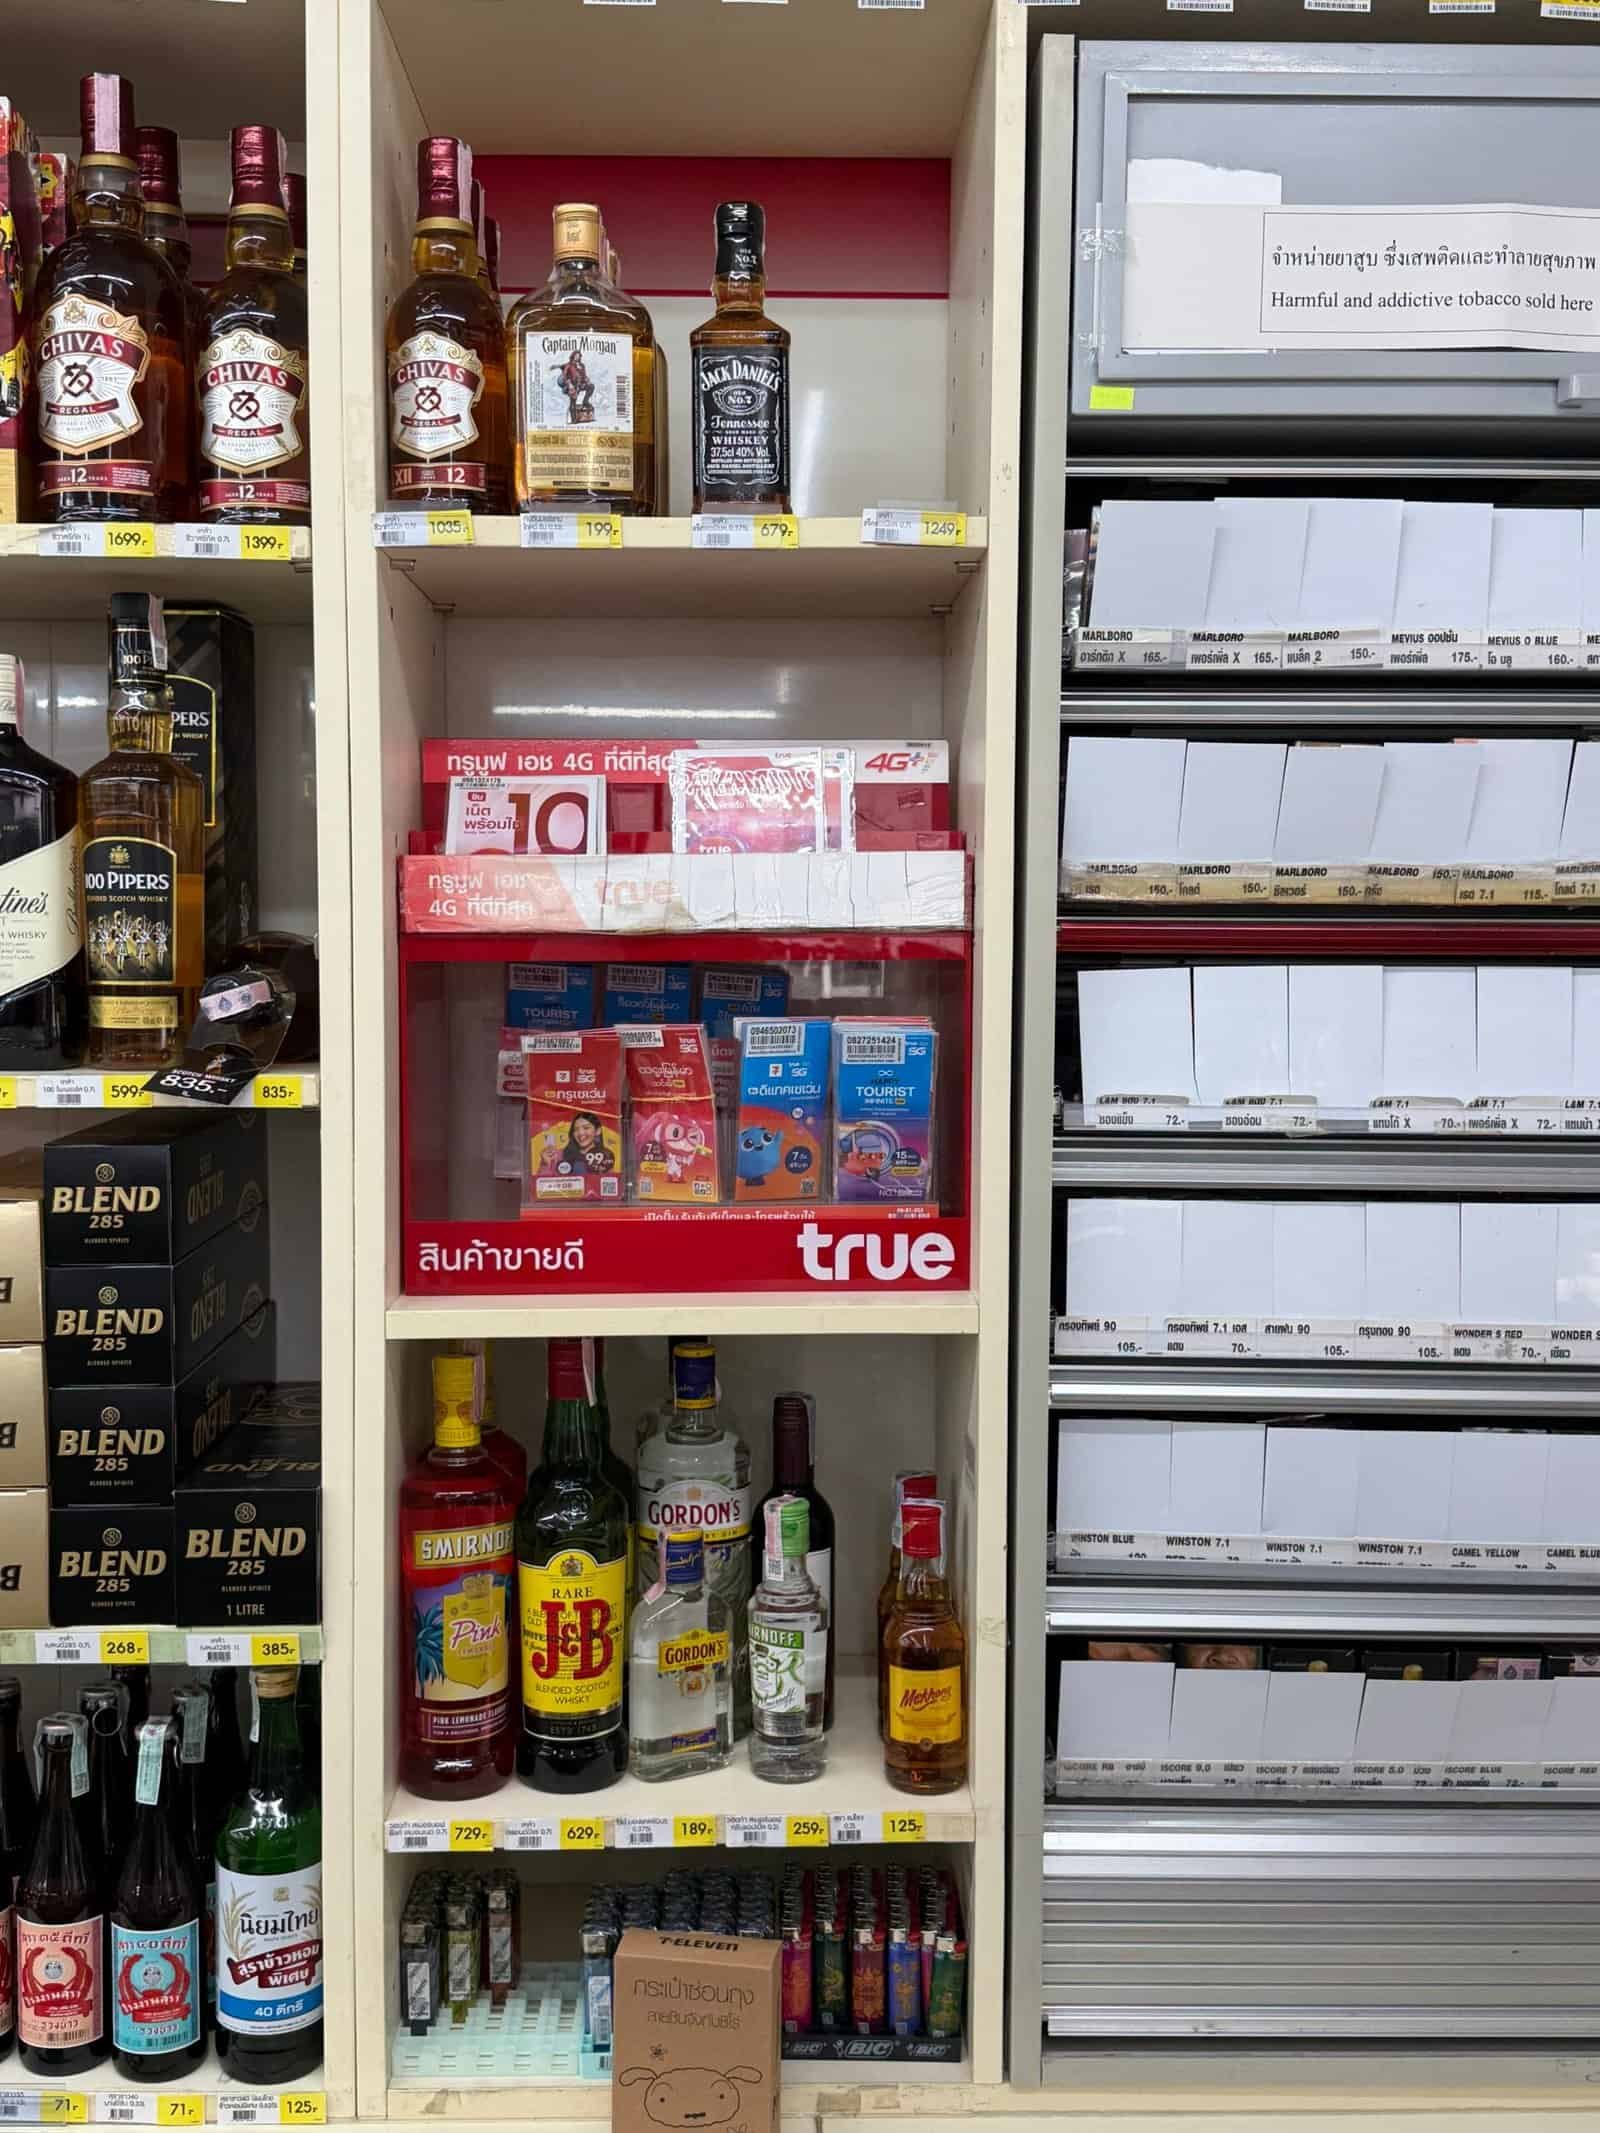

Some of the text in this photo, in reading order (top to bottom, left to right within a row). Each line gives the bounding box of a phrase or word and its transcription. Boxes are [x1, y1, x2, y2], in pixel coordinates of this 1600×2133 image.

[1271, 240, 1596, 273] จำหน่ายยาสูบ ซึ่งเสพติดและทำลายสุขภาพ
[1270, 290, 1593, 311] Harmful and addictive tobacco sold here
[40, 332, 126, 360] CHIVAS
[542, 336, 618, 354] Captain Morgan
[206, 366, 290, 388] CHIVAS
[396, 362, 466, 384] CHIVAS
[700, 359, 782, 392] JACK DANIEL'S
[727, 396, 753, 405] No.7
[58, 406, 98, 415] REGAL
[412, 418, 442, 428] REGAL
[710, 415, 770, 429] Tennessee
[226, 428, 262, 437] REGAL
[712, 436, 769, 446] WHISKEY
[736, 447, 755, 457] 40%
[70, 467, 88, 483] 12
[394, 467, 465, 486] XII 12
[239, 484, 256, 498] 12
[1082, 630, 1133, 642] MARLBORO
[1192, 632, 1244, 642] MARLBORO
[1287, 630, 1340, 642] MARLBORO
[1391, 633, 1424, 643] MEVIUS
[1488, 636, 1559, 646] MEVIUS BLUE
[1118, 651, 1168, 663] X 165.-
[1253, 652, 1279, 664] 165.-
[1350, 648, 1376, 659] 150.-
[1452, 652, 1478, 663] 175.-
[1548, 654, 1574, 665] 160.-
[447, 752, 507, 777] ทรูมูฟ
[517, 753, 553, 771] เอช
[563, 752, 593, 771] 4G
[465, 803, 491, 816] เน็ต
[508, 792, 589, 854] 10
[1180, 865, 1231, 875] MARLBORO
[85, 871, 169, 890] 100 PIPERS
[428, 872, 484, 894] ทรูมูฟ
[139, 895, 168, 903] WHISKY
[428, 900, 457, 916] 4G
[8, 931, 47, 939] WHISKY
[523, 1008, 579, 1020] TOURIST
[160, 1074, 228, 1094] 835.-
[856, 1086, 916, 1098] TOURIST
[1564, 1100, 1585, 1109] L&M
[1166, 1114, 1186, 1126] 72.-
[1536, 1119, 1557, 1129] 72.-
[585, 1153, 604, 1165] 99
[52, 1186, 161, 1213] BLEND
[88, 1215, 124, 1229] 285
[418, 1222, 956, 1281] สินค้าขายดี true
[54, 1308, 164, 1336] BLEND
[1058, 1318, 1117, 1332] กรองทิพย์ 90
[1167, 1319, 1209, 1334] กรองทิพย์
[1213, 1323, 1228, 1334] 7.1
[1297, 1324, 1310, 1335] 90
[1358, 1326, 1394, 1340] กรุงทอง
[1454, 1328, 1522, 1339] WONDER RED
[1551, 1330, 1592, 1341] WONDER
[91, 1337, 127, 1351] 285
[1117, 1342, 1143, 1353] 105.-
[1168, 1342, 1252, 1353] แดง 70.-
[1324, 1344, 1350, 1356] 105.-
[1417, 1347, 1444, 1358] 105.-
[1521, 1348, 1541, 1359] 70.-
[57, 1428, 165, 1457] BLEND
[93, 1457, 129, 1472] 285
[649, 1499, 741, 1526] GORDON'S
[185, 1527, 307, 1559] BLEND
[1112, 1534, 1135, 1544] BLUE
[1166, 1536, 1230, 1548] WINSTON 7.1
[1266, 1542, 1306, 1553] WINSTON
[1358, 1543, 1404, 1554] WINSTON
[1452, 1547, 1520, 1558] CAMEL YELLOW
[1546, 1548, 1576, 1558] CAMEL
[59, 1549, 167, 1578] BLEND
[226, 1560, 265, 1576] 285
[96, 1578, 130, 1592] 285
[552, 1587, 592, 1599] RARE
[235, 1604, 265, 1616] LITRE
[449, 1614, 502, 1649] Pink
[530, 1598, 614, 1680] J&B
[664, 1640, 724, 1665] GORDON'S
[535, 1680, 610, 1695] BLENDED SCOTCH
[554, 1696, 590, 1705] WHISKY
[1160, 1764, 1192, 1773] ISCORE
[1256, 1766, 1288, 1775] ISCORE
[240, 1908, 319, 1935] นิยมไทย
[238, 1944, 320, 1978] สุราข้าวหอม
[268, 1968, 310, 1986] พิเศษ
[254, 2000, 304, 2017] 40 ดีกรี
[849, 2041, 890, 2056] BIC
